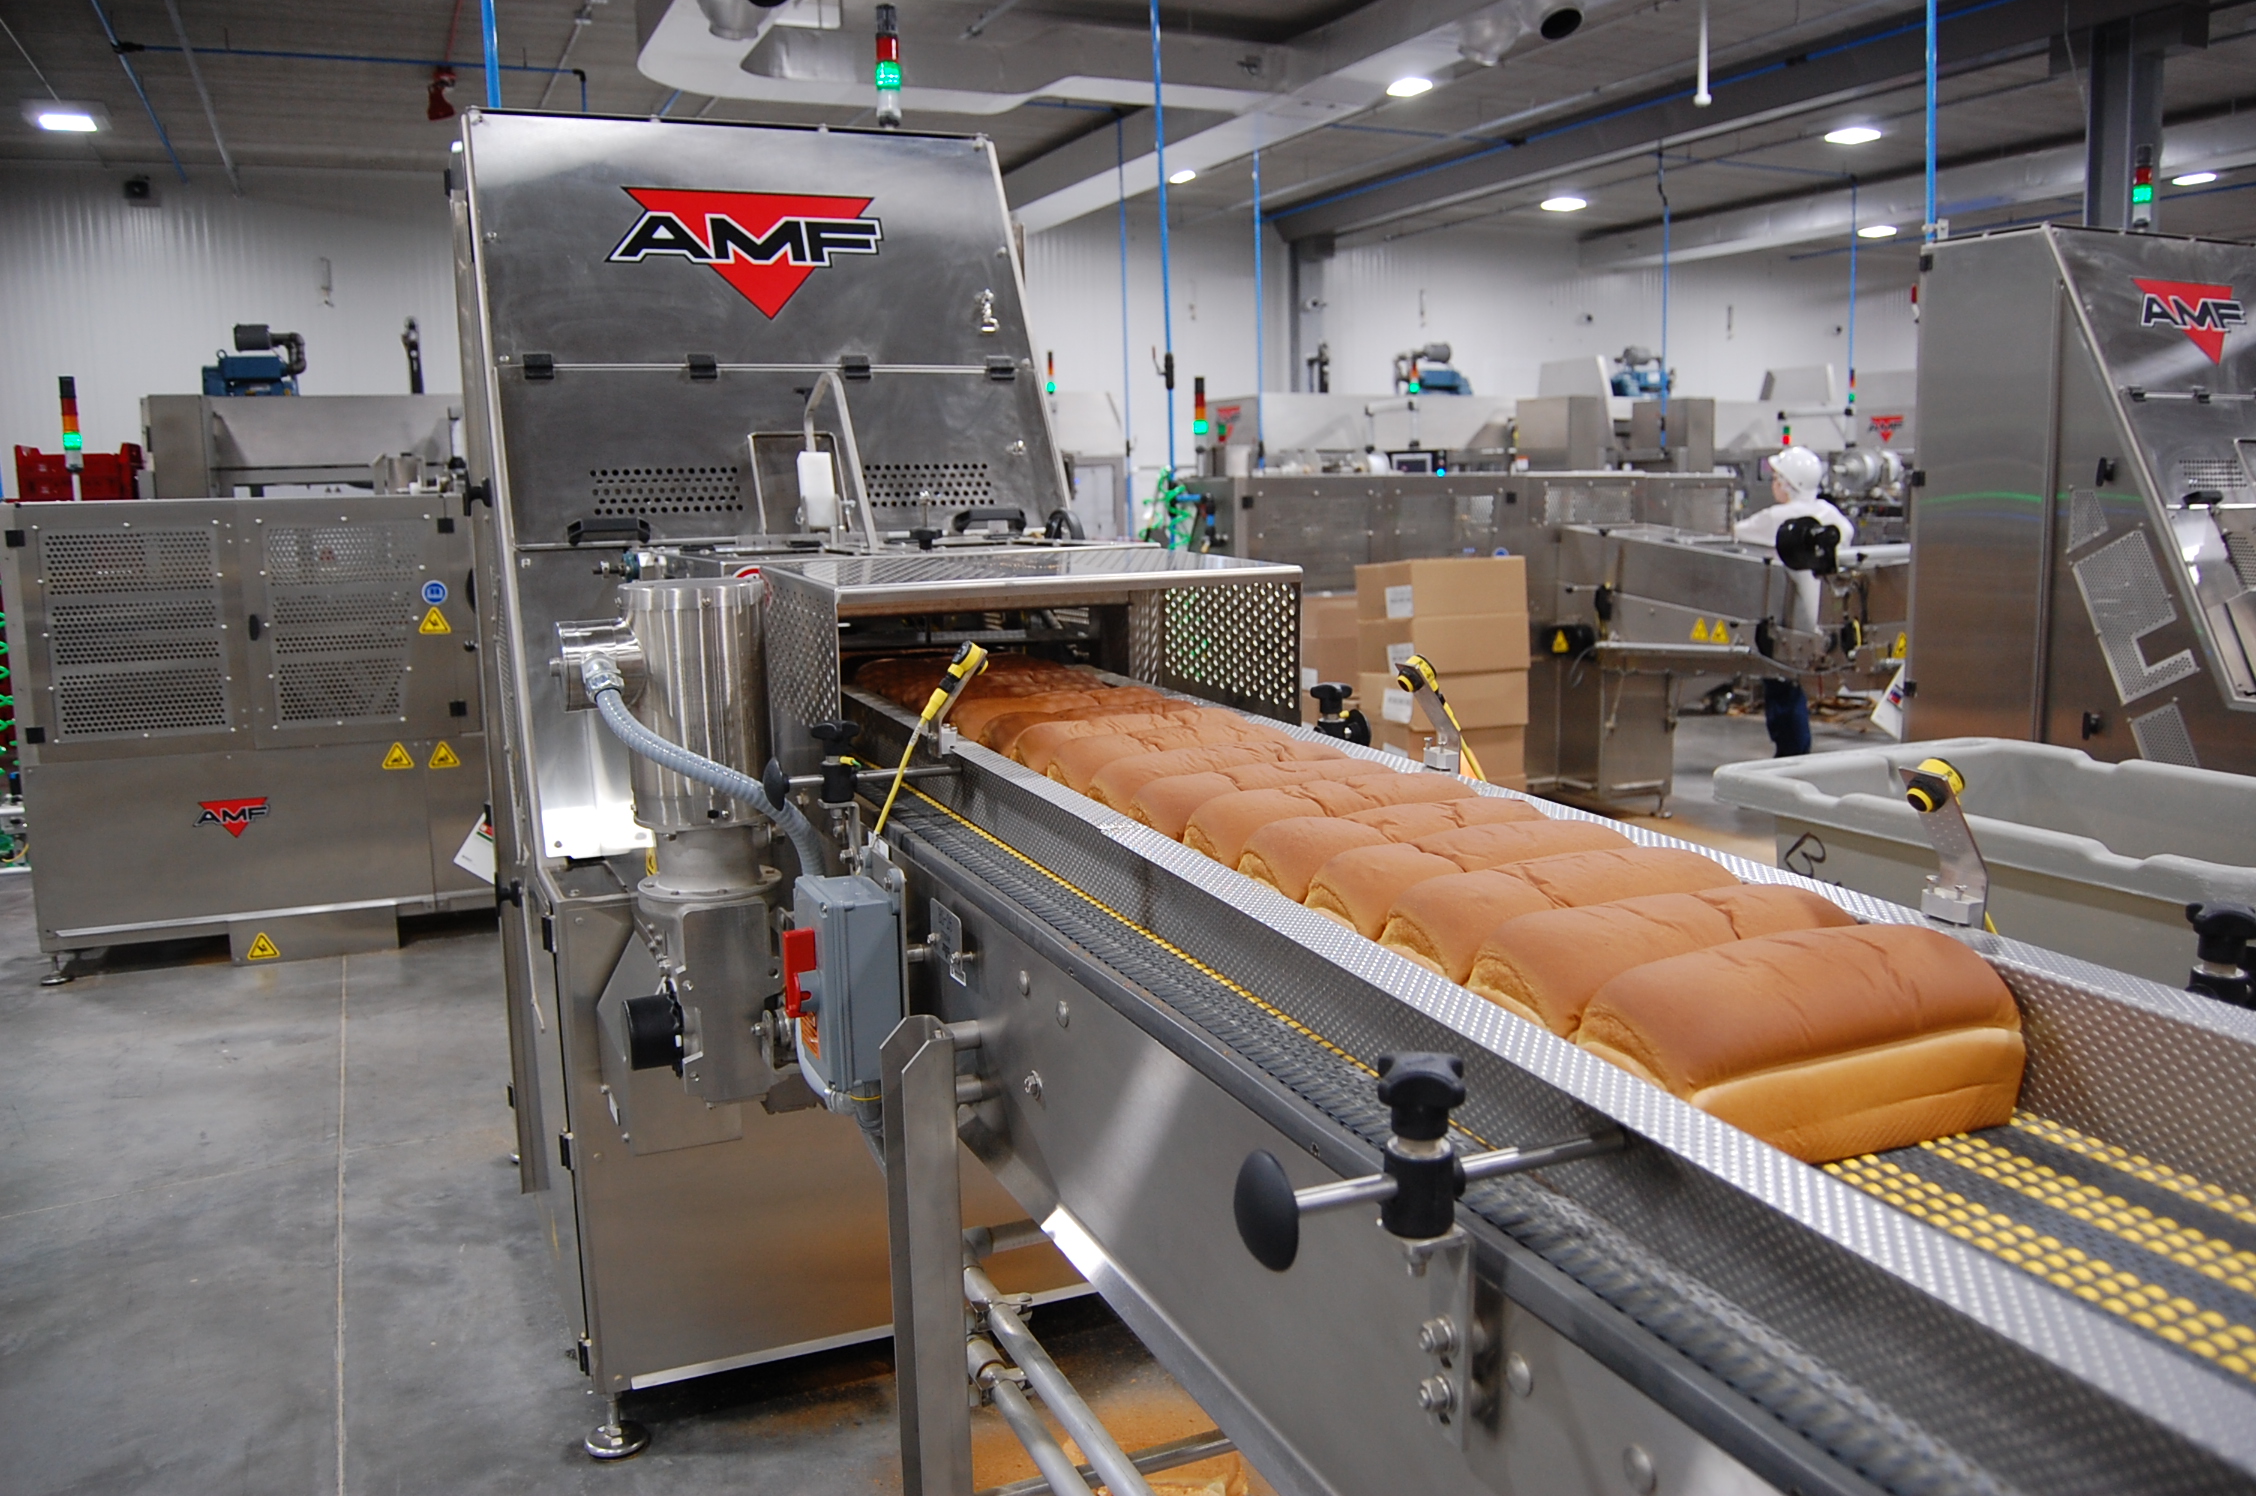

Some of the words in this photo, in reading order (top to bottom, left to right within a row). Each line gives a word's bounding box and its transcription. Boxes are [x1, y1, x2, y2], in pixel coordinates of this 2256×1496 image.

[604, 210, 883, 267] AMF
[2140, 293, 2246, 333] AMF
[193, 804, 270, 827] AMF
